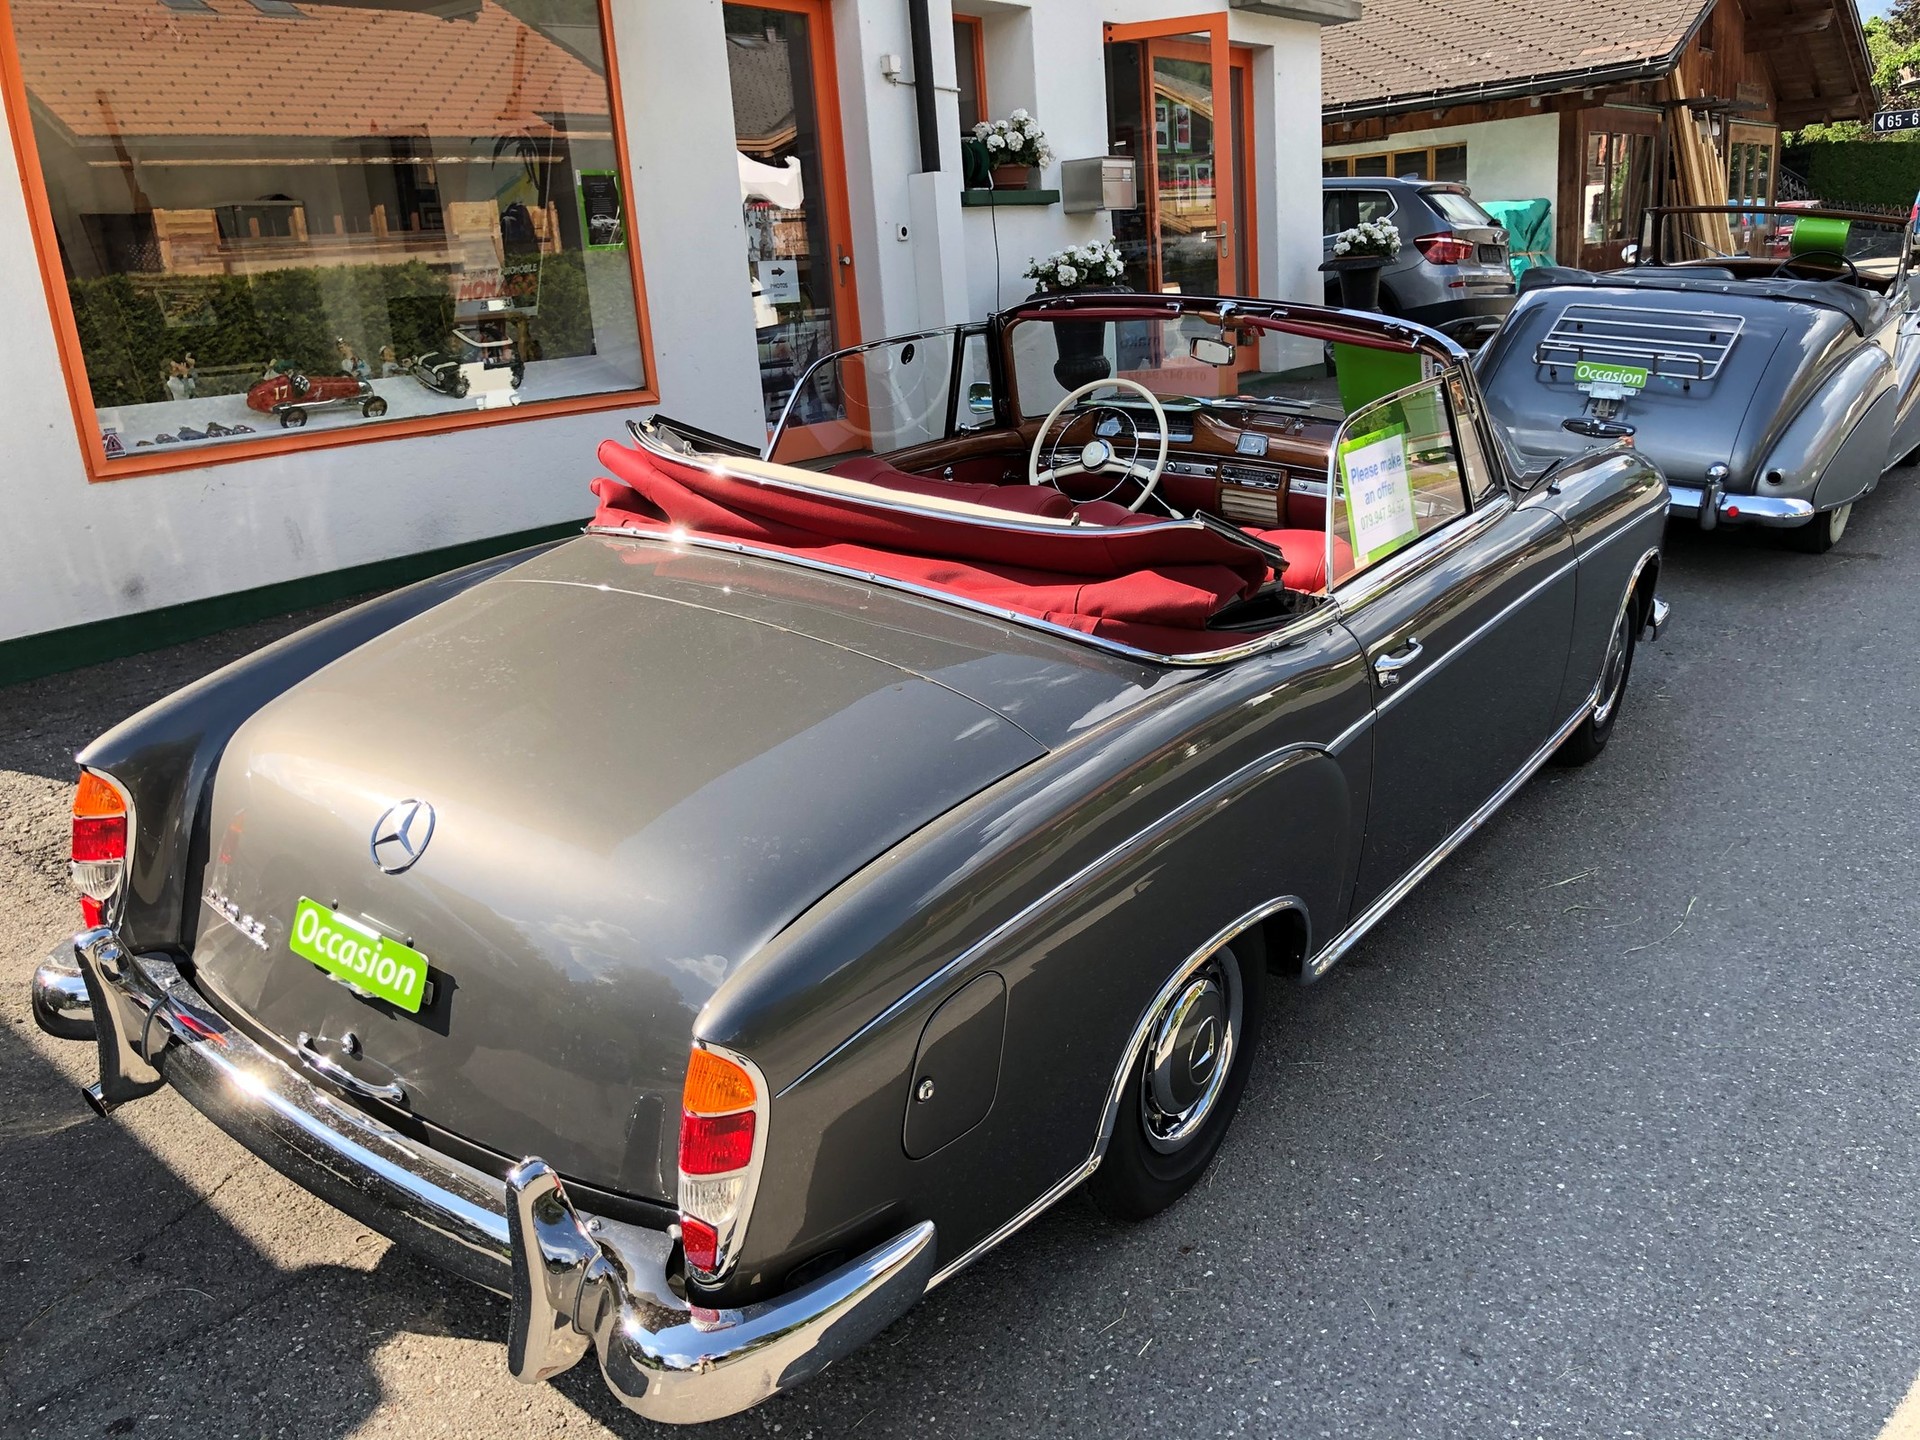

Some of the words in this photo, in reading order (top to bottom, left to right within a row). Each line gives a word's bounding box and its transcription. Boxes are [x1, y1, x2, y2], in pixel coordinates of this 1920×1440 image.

[458, 273, 538, 302] MONACO
[1577, 365, 1643, 385] Occasion
[273, 384, 289, 401] 17
[1350, 465, 1378, 484] Please
[1380, 453, 1402, 473] make
[1364, 489, 1376, 506] an
[1377, 480, 1395, 500] offer
[297, 907, 417, 997] Occasion
